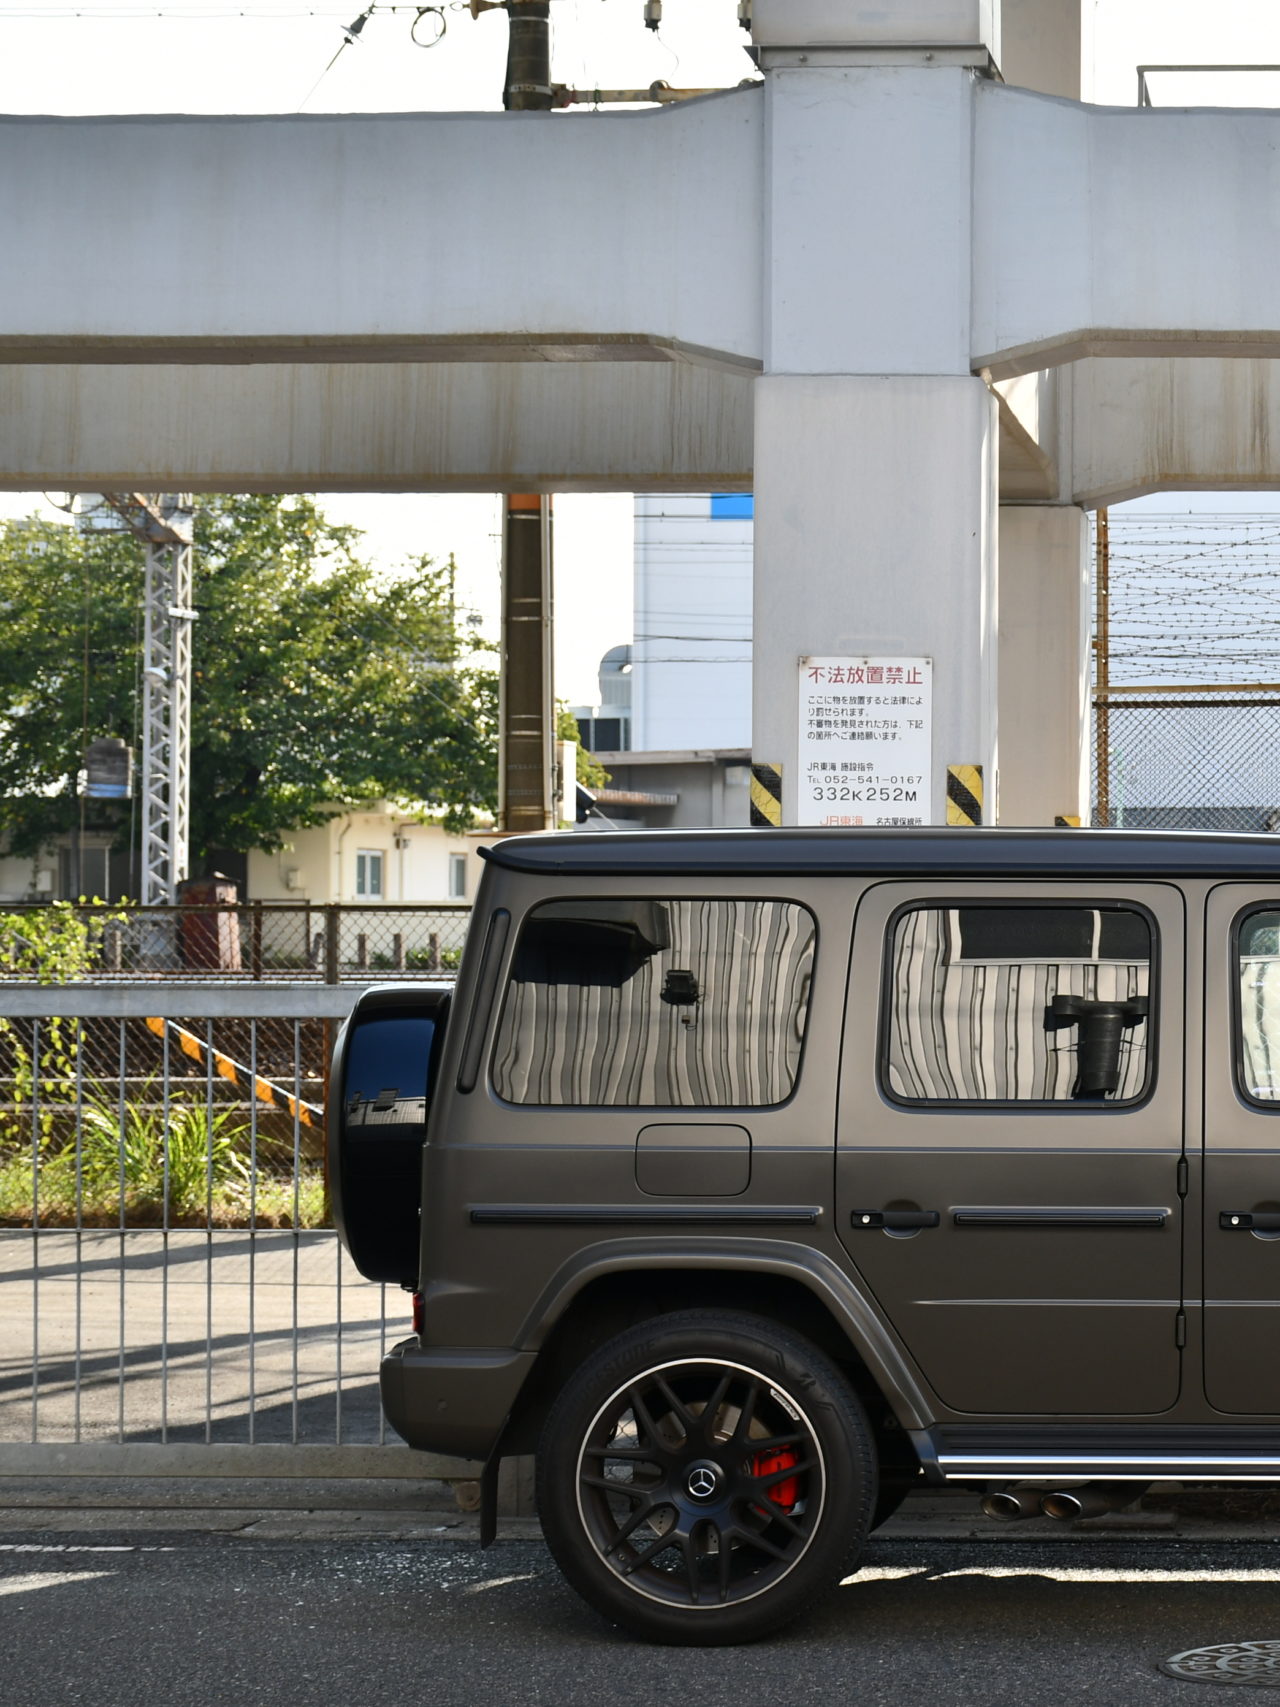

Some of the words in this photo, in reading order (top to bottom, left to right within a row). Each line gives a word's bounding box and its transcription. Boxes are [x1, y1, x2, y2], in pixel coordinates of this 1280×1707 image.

[807, 665, 924, 685] 不法放置禁止
[807, 695, 924, 706] ここに物を放置すると法律によ
[806, 762, 837, 772] JR東海
[840, 762, 874, 772] 施設指令
[820, 815, 863, 826] JR東海
